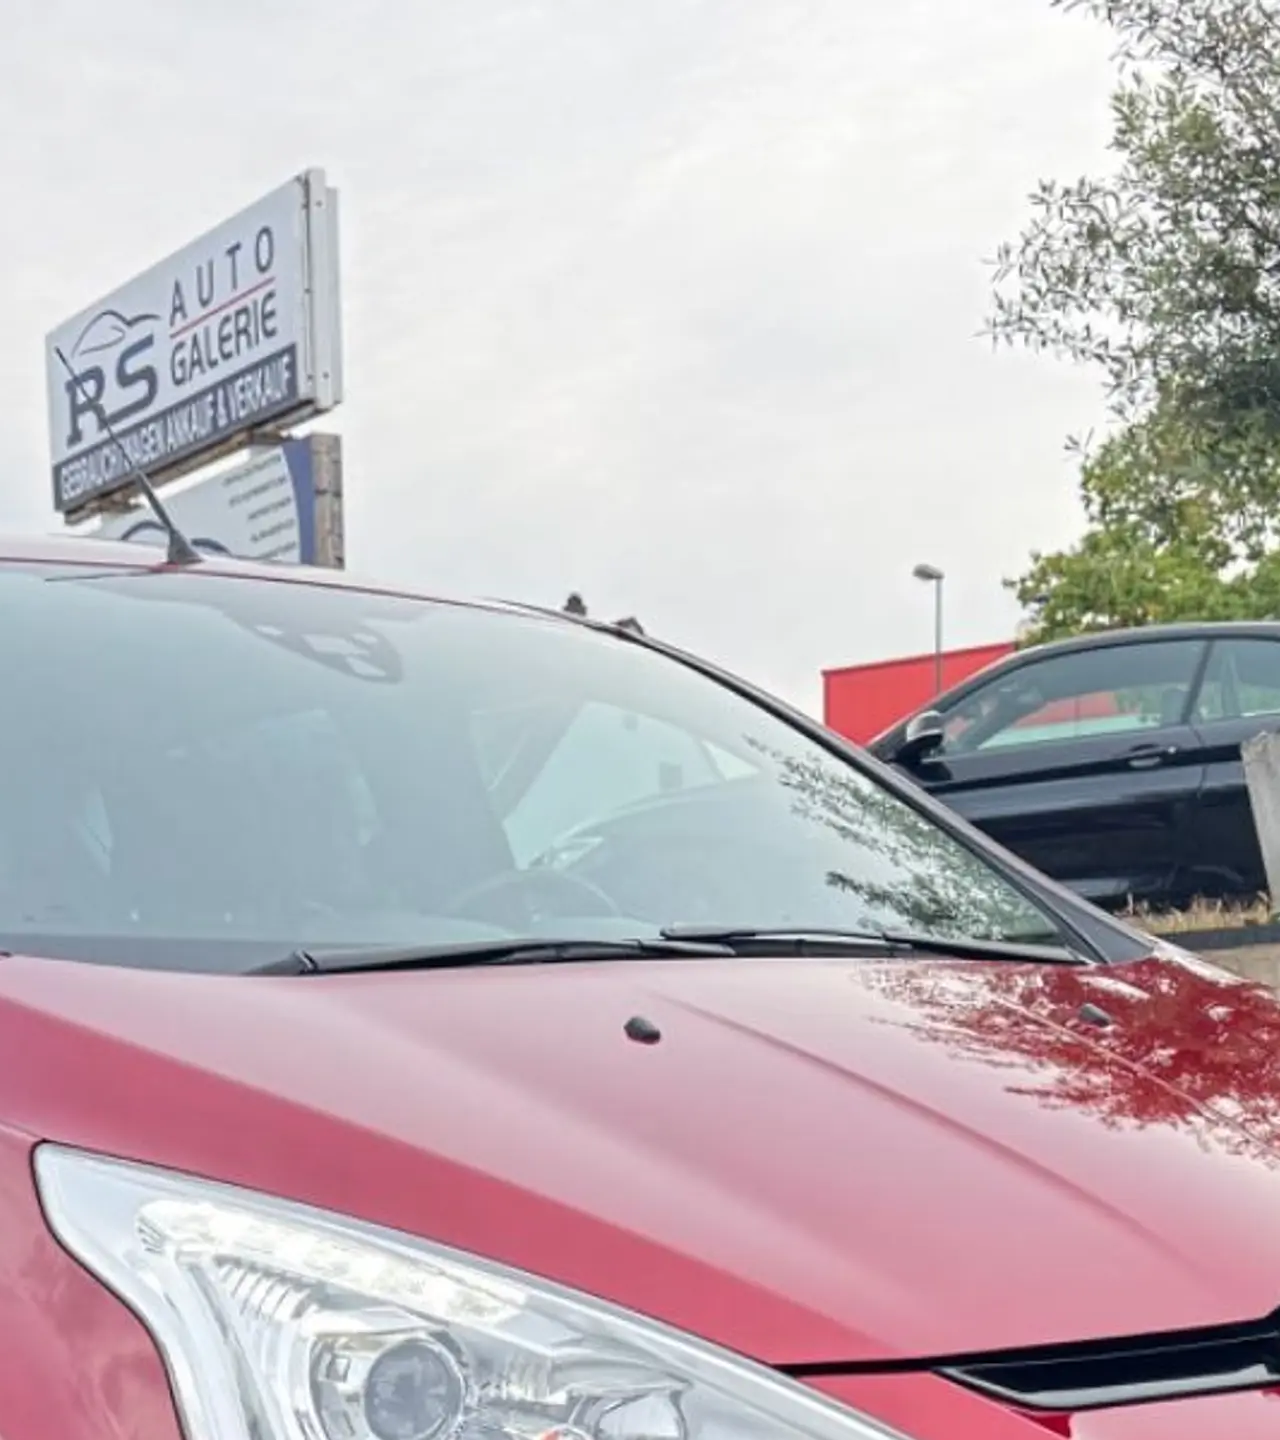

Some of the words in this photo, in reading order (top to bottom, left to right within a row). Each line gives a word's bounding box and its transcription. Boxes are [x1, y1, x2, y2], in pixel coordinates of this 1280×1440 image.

[170, 226, 274, 327] AUTO
[171, 290, 277, 386] GALERIE
[65, 334, 158, 449] RS
